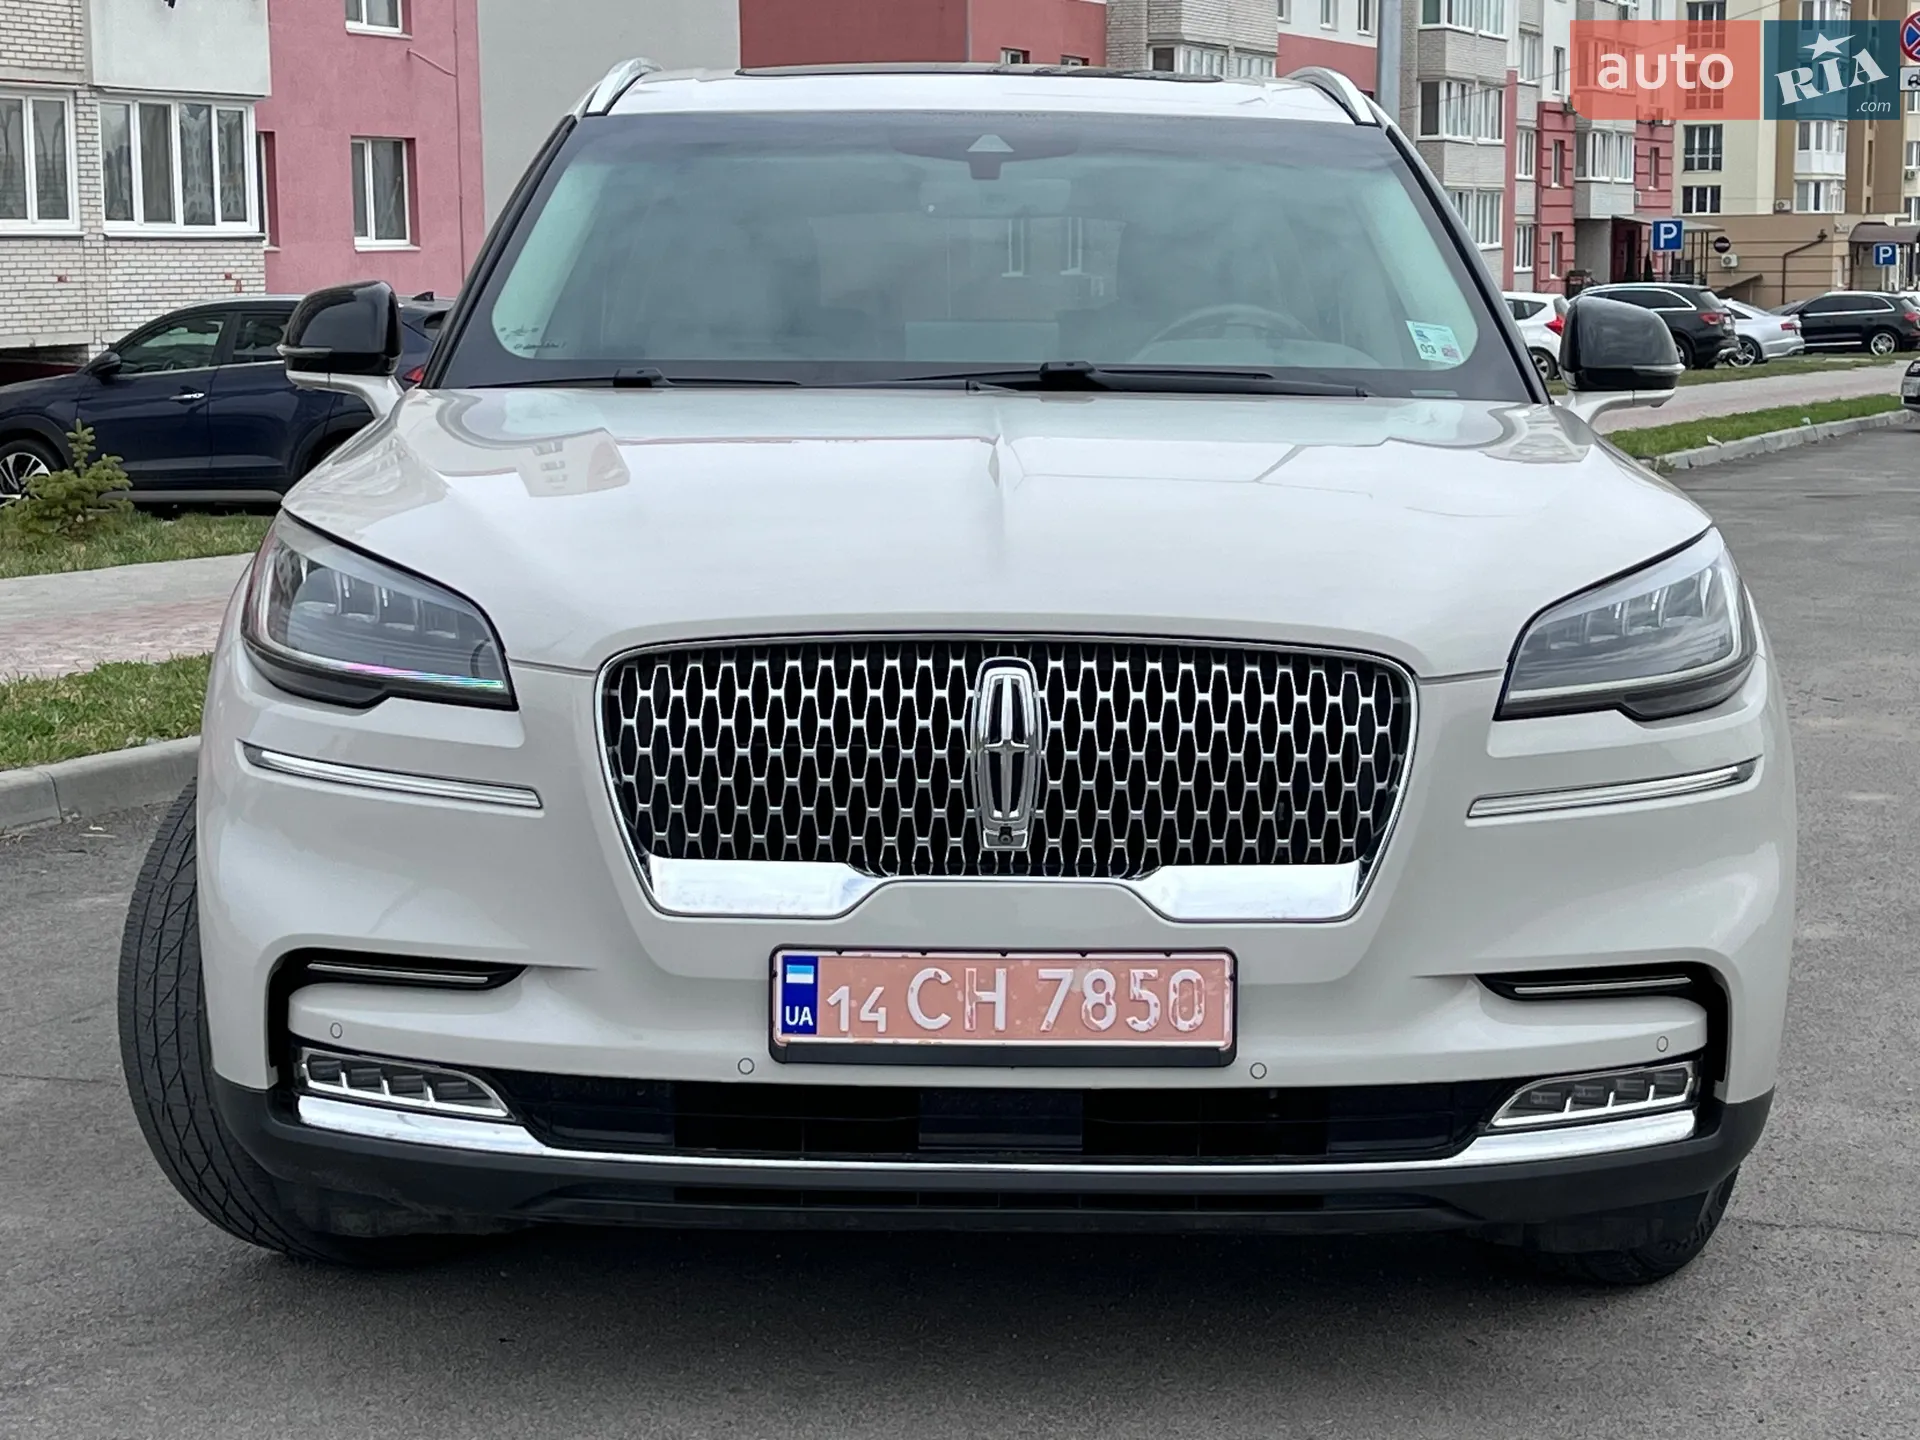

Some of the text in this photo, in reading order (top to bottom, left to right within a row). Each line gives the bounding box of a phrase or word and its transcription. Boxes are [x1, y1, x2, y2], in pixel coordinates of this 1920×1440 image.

[1659, 223, 1678, 248] P
[1879, 246, 1893, 265] P
[826, 967, 1206, 1032] 14 CH 7850
[784, 1005, 814, 1027] UA
